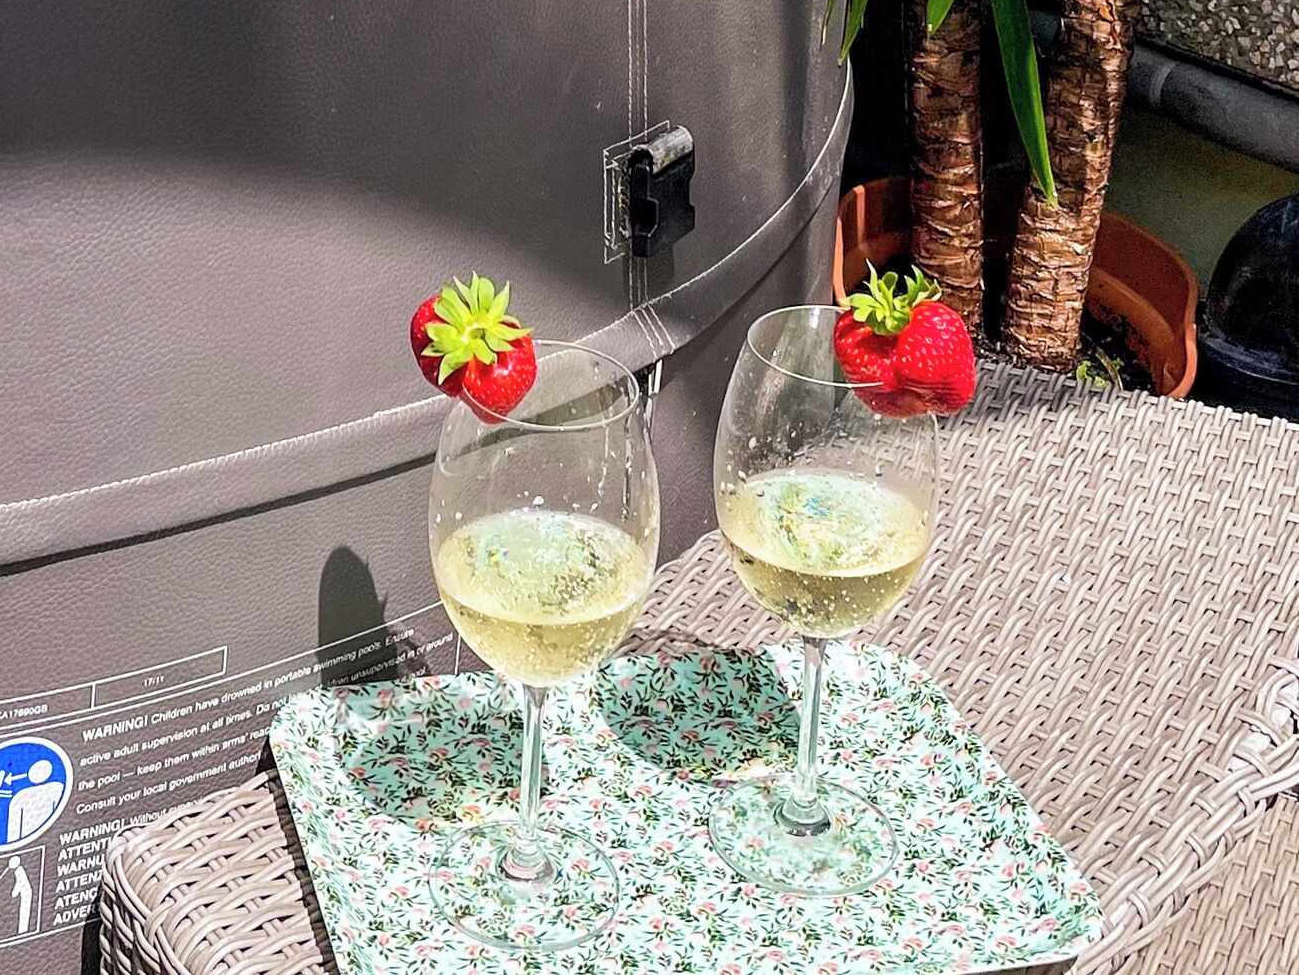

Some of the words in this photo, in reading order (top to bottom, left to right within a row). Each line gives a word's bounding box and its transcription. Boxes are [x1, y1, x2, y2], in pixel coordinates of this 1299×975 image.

[79, 751, 112, 767] active
[113, 743, 139, 758] adult
[141, 727, 198, 752] supervision
[200, 722, 210, 734] at
[212, 716, 224, 730] all
[256, 703, 270, 715] Do
[272, 697, 287, 709] not
[351, 651, 406, 681] unsupervised
[407, 648, 416, 659] in
[417, 644, 427, 655] or
[426, 632, 454, 650] around
[82, 715, 149, 742] WARNING!
[151, 705, 193, 725] Children
[195, 697, 219, 712] have
[221, 682, 262, 703] drowned
[264, 679, 273, 689] in
[274, 666, 312, 688] portable
[313, 650, 357, 673] swimming
[385, 628, 415, 647] Ensure
[78, 779, 95, 791] the
[97, 771, 121, 789] pool
[136, 760, 162, 776] keep
[164, 753, 189, 768] them
[191, 743, 220, 759] within
[249, 726, 270, 740] reac
[76, 796, 116, 814] Consult
[118, 790, 141, 806] your
[143, 781, 167, 797] local
[168, 763, 227, 791] government
[228, 750, 263, 770] authori
[59, 817, 126, 846] WARNING!
[129, 808, 167, 826] Without
[55, 869, 103, 894] ATTENZ
[56, 852, 105, 877] WARNU
[53, 903, 96, 926] ADVER
[54, 886, 99, 910] ATENÇ
